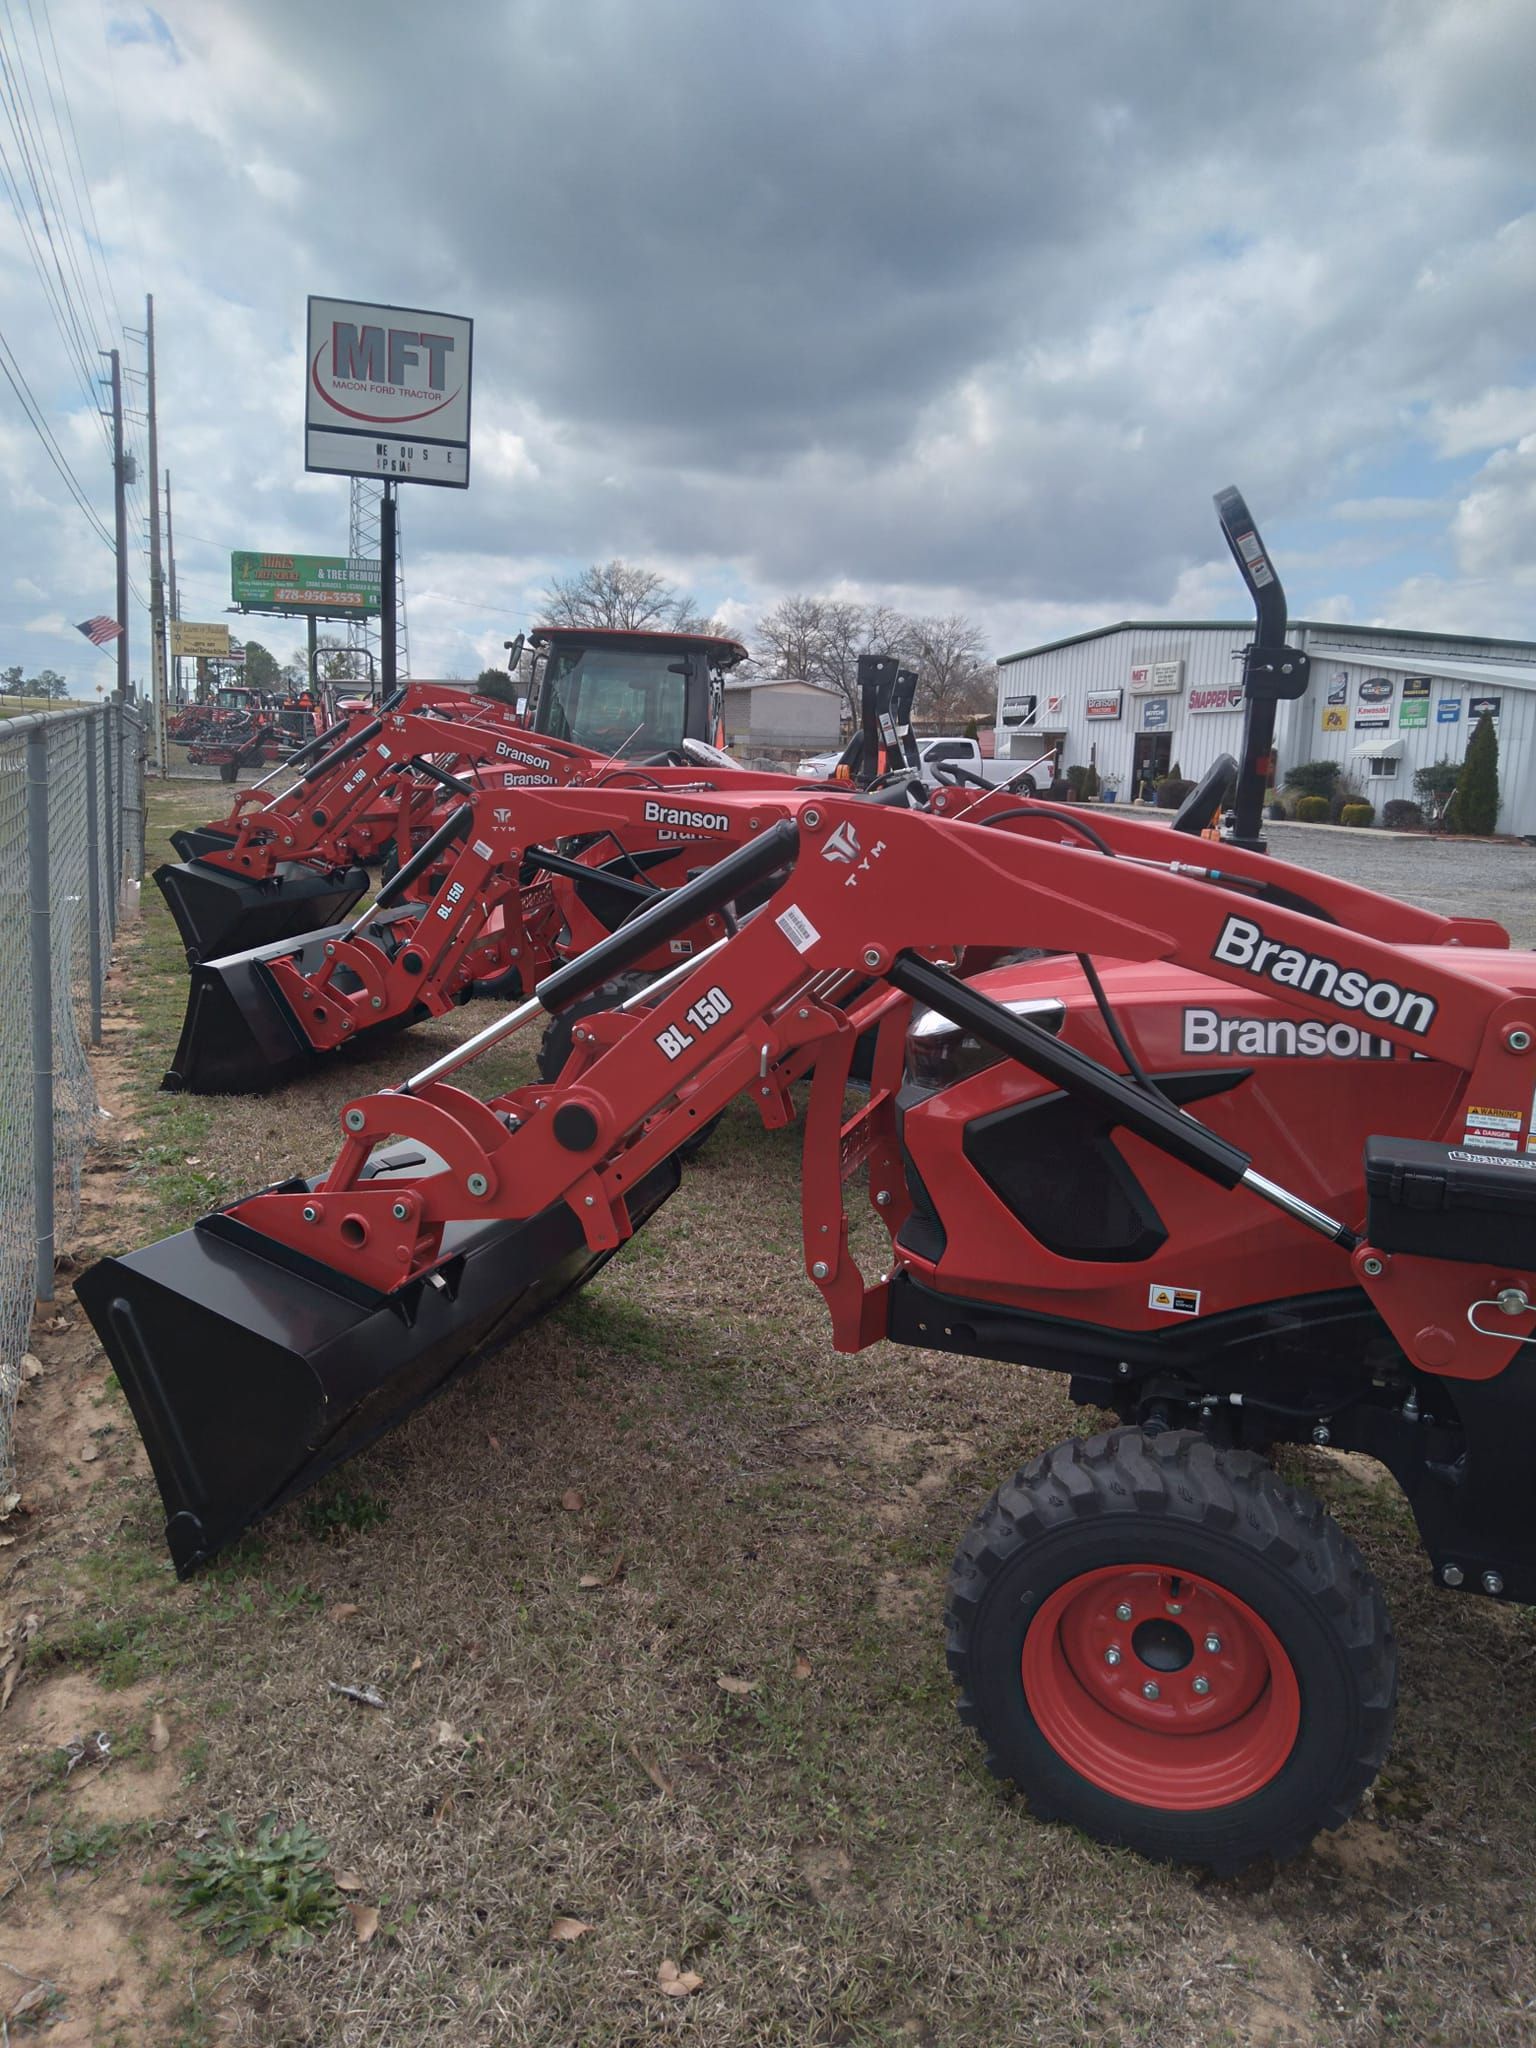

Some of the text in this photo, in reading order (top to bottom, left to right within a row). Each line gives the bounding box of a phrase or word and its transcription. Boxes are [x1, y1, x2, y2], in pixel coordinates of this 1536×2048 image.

[332, 321, 455, 391] MFT
[332, 380, 441, 401] MACON FORD TRACTOR
[318, 568, 325, 579] &
[327, 569, 347, 580] TREE
[1132, 669, 1149, 681] MFT
[1088, 698, 1118, 708] Branson
[1189, 690, 1227, 709] SNAPPER
[1358, 706, 1389, 715] Kawasaki
[496, 741, 550, 770] Branson
[352, 769, 367, 783] 150
[645, 801, 728, 831] Branson
[437, 882, 465, 920] BL 150
[1214, 916, 1436, 1032] Branson
[656, 987, 732, 1060] BL 150
[1481, 1107, 1518, 1118] WARNING
[1482, 1129, 1511, 1138] DANGER
